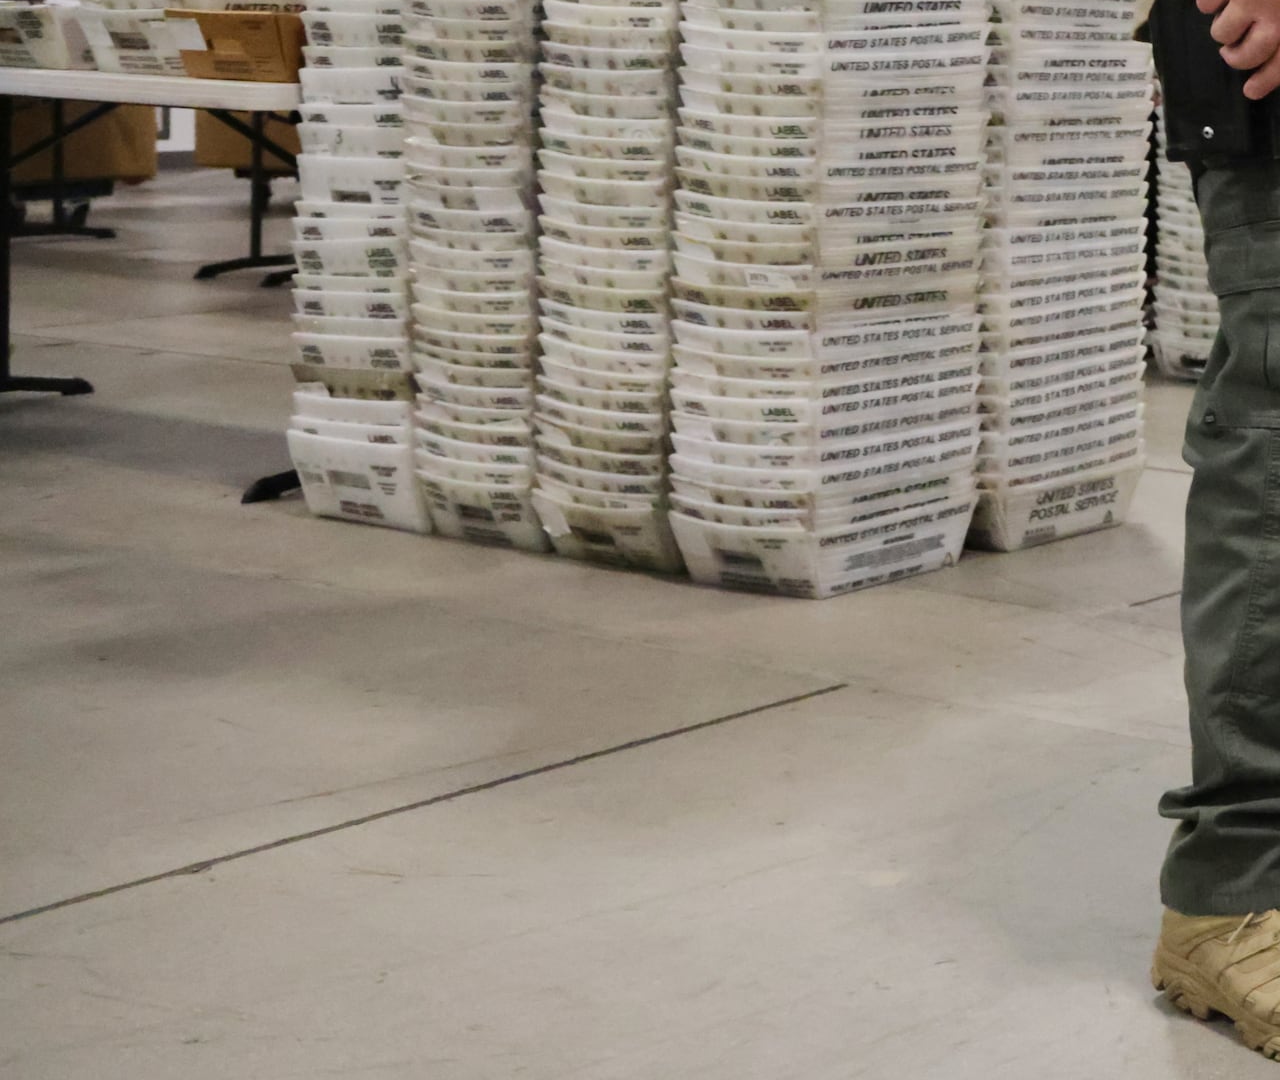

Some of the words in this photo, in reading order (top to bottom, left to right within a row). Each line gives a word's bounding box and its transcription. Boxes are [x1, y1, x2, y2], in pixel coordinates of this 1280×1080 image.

[828, 39, 867, 49] UNITED
[870, 37, 907, 47] STATES
[910, 34, 943, 45] POSTAL
[947, 30, 981, 42] SERVICE
[769, 125, 805, 136] LABEL
[766, 210, 801, 220] LABEL
[826, 207, 864, 217] UNITED
[866, 205, 903, 216] STATES
[906, 204, 940, 214] POSTAL
[944, 201, 978, 212] SERVICE
[855, 251, 901, 266] UNITED
[905, 248, 947, 262] STATES
[853, 295, 900, 310] UNITED
[902, 290, 948, 304] STATES
[1010, 296, 1042, 308] UNITED
[1045, 290, 1076, 303] STATES
[1078, 287, 1107, 298] POSTAL
[1110, 280, 1139, 293] SERVICE
[823, 334, 860, 347] UNITED
[863, 330, 899, 343] STATES
[902, 327, 936, 339] POSTAL
[939, 323, 973, 335] SERVICE
[822, 401, 859, 415] UNITED
[862, 396, 898, 409] STATES
[901, 389, 934, 403] POSTAL
[938, 383, 973, 397] SERVICE
[1008, 433, 1042, 446] UNITED
[1044, 426, 1075, 440] STATES
[1076, 419, 1104, 432] POSTAL
[1108, 410, 1136, 424] SERVICE
[821, 448, 860, 462] UNITED
[863, 441, 899, 456] STATES
[901, 434, 935, 448] POSTAL
[938, 427, 972, 442] SERVICE
[1008, 454, 1041, 467] UNITED
[1043, 447, 1074, 461] STATES
[1076, 440, 1105, 452] POSTAL
[1108, 429, 1137, 445] SERVICE
[1036, 486, 1076, 505] UNITED
[1078, 476, 1115, 496] STATES
[1029, 504, 1070, 522] POSTAL
[1075, 490, 1119, 511] SERVICE
